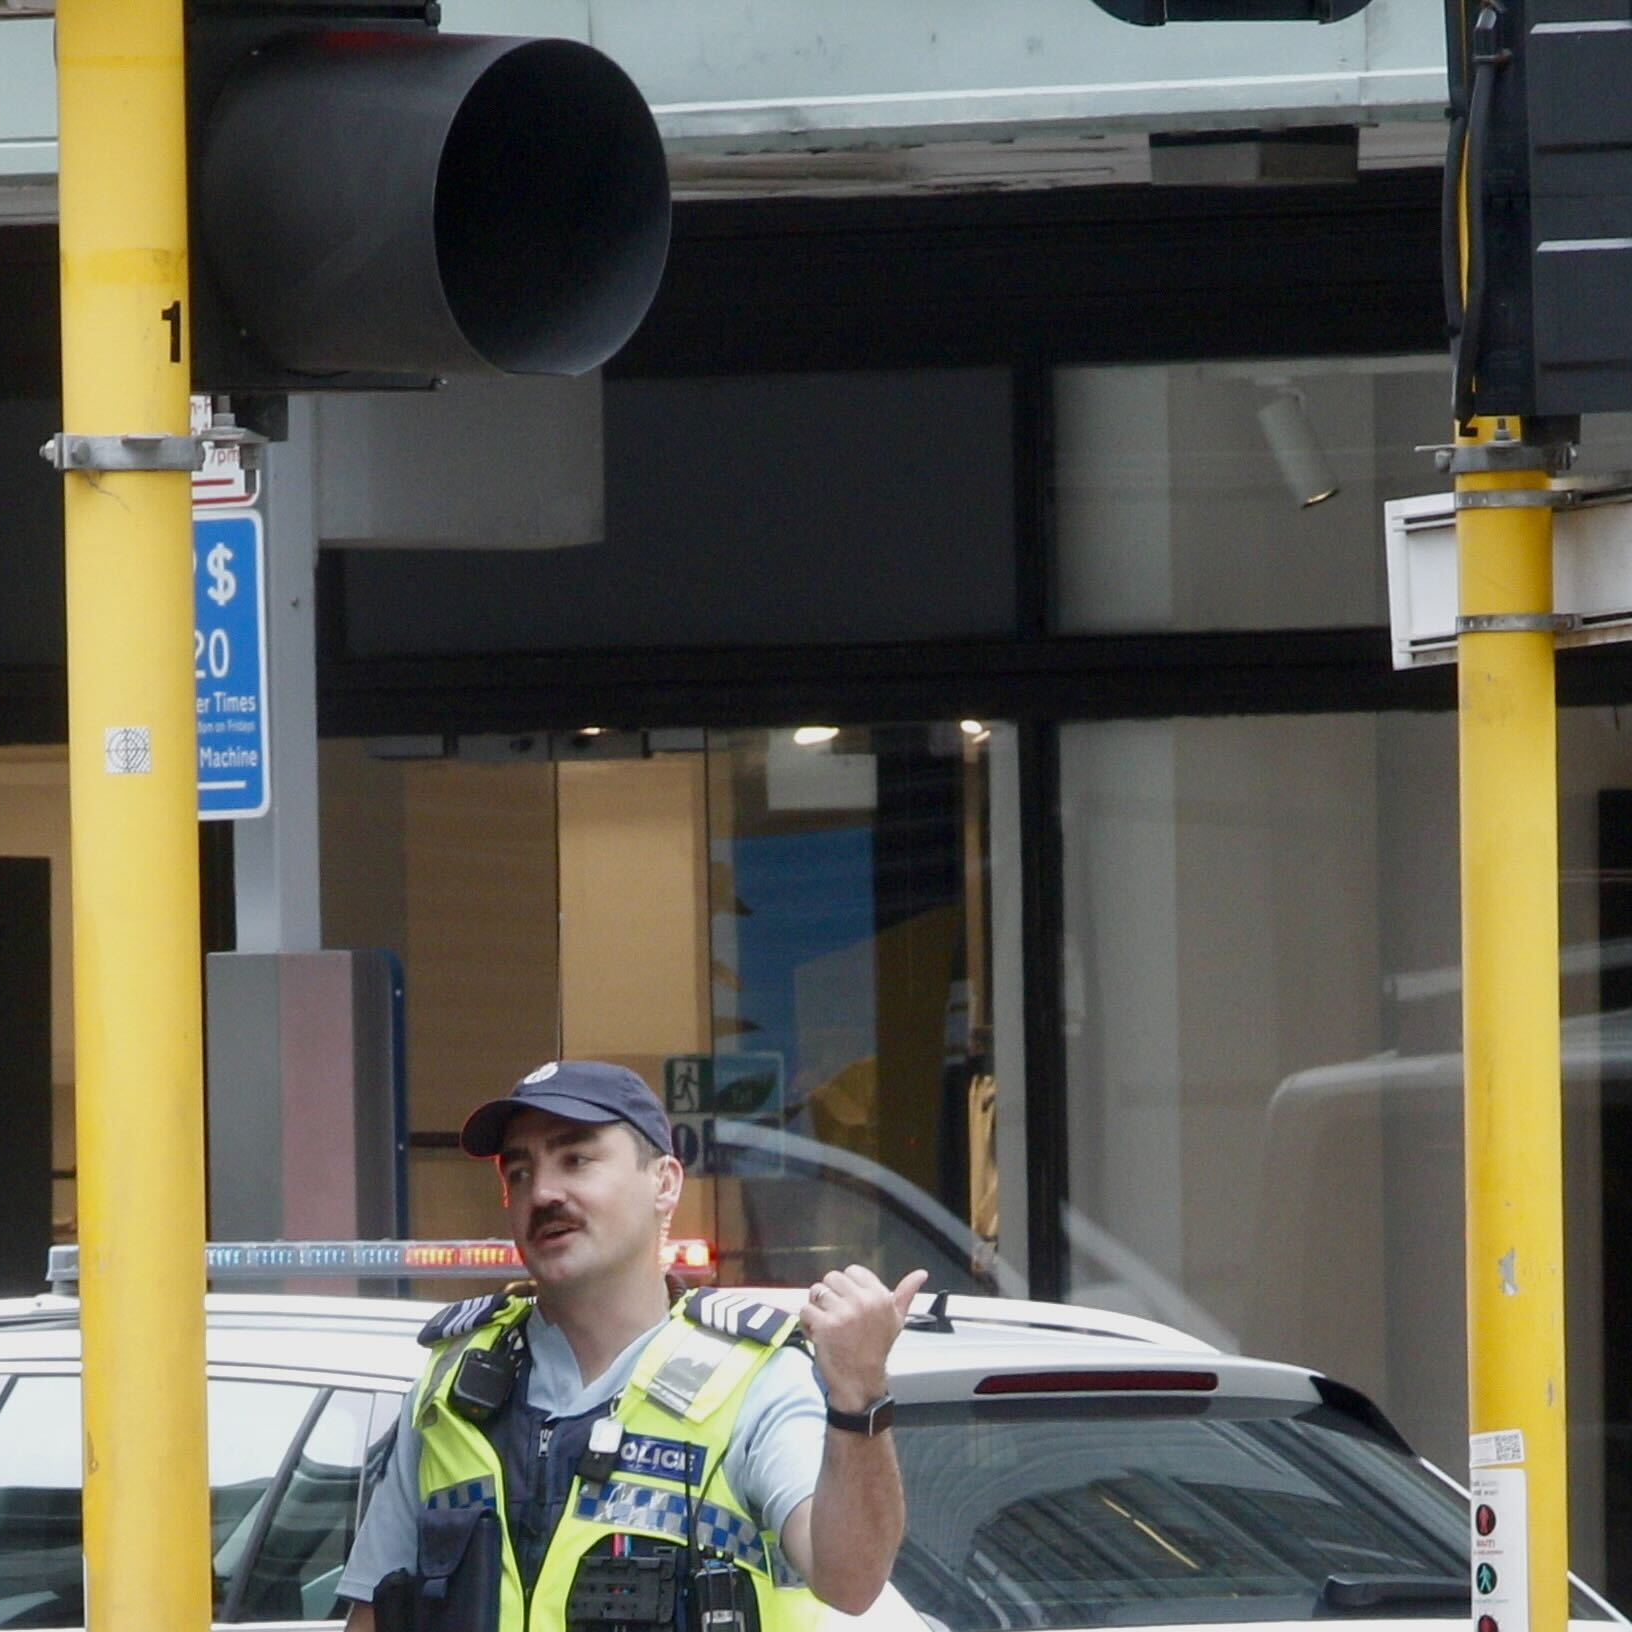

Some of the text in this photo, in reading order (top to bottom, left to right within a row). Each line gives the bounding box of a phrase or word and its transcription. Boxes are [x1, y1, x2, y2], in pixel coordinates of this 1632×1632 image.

[161, 300, 181, 363] 1
[196, 690, 256, 713] er Times
[200, 745, 258, 768] Machine
[619, 1440, 696, 1472] OLICE
